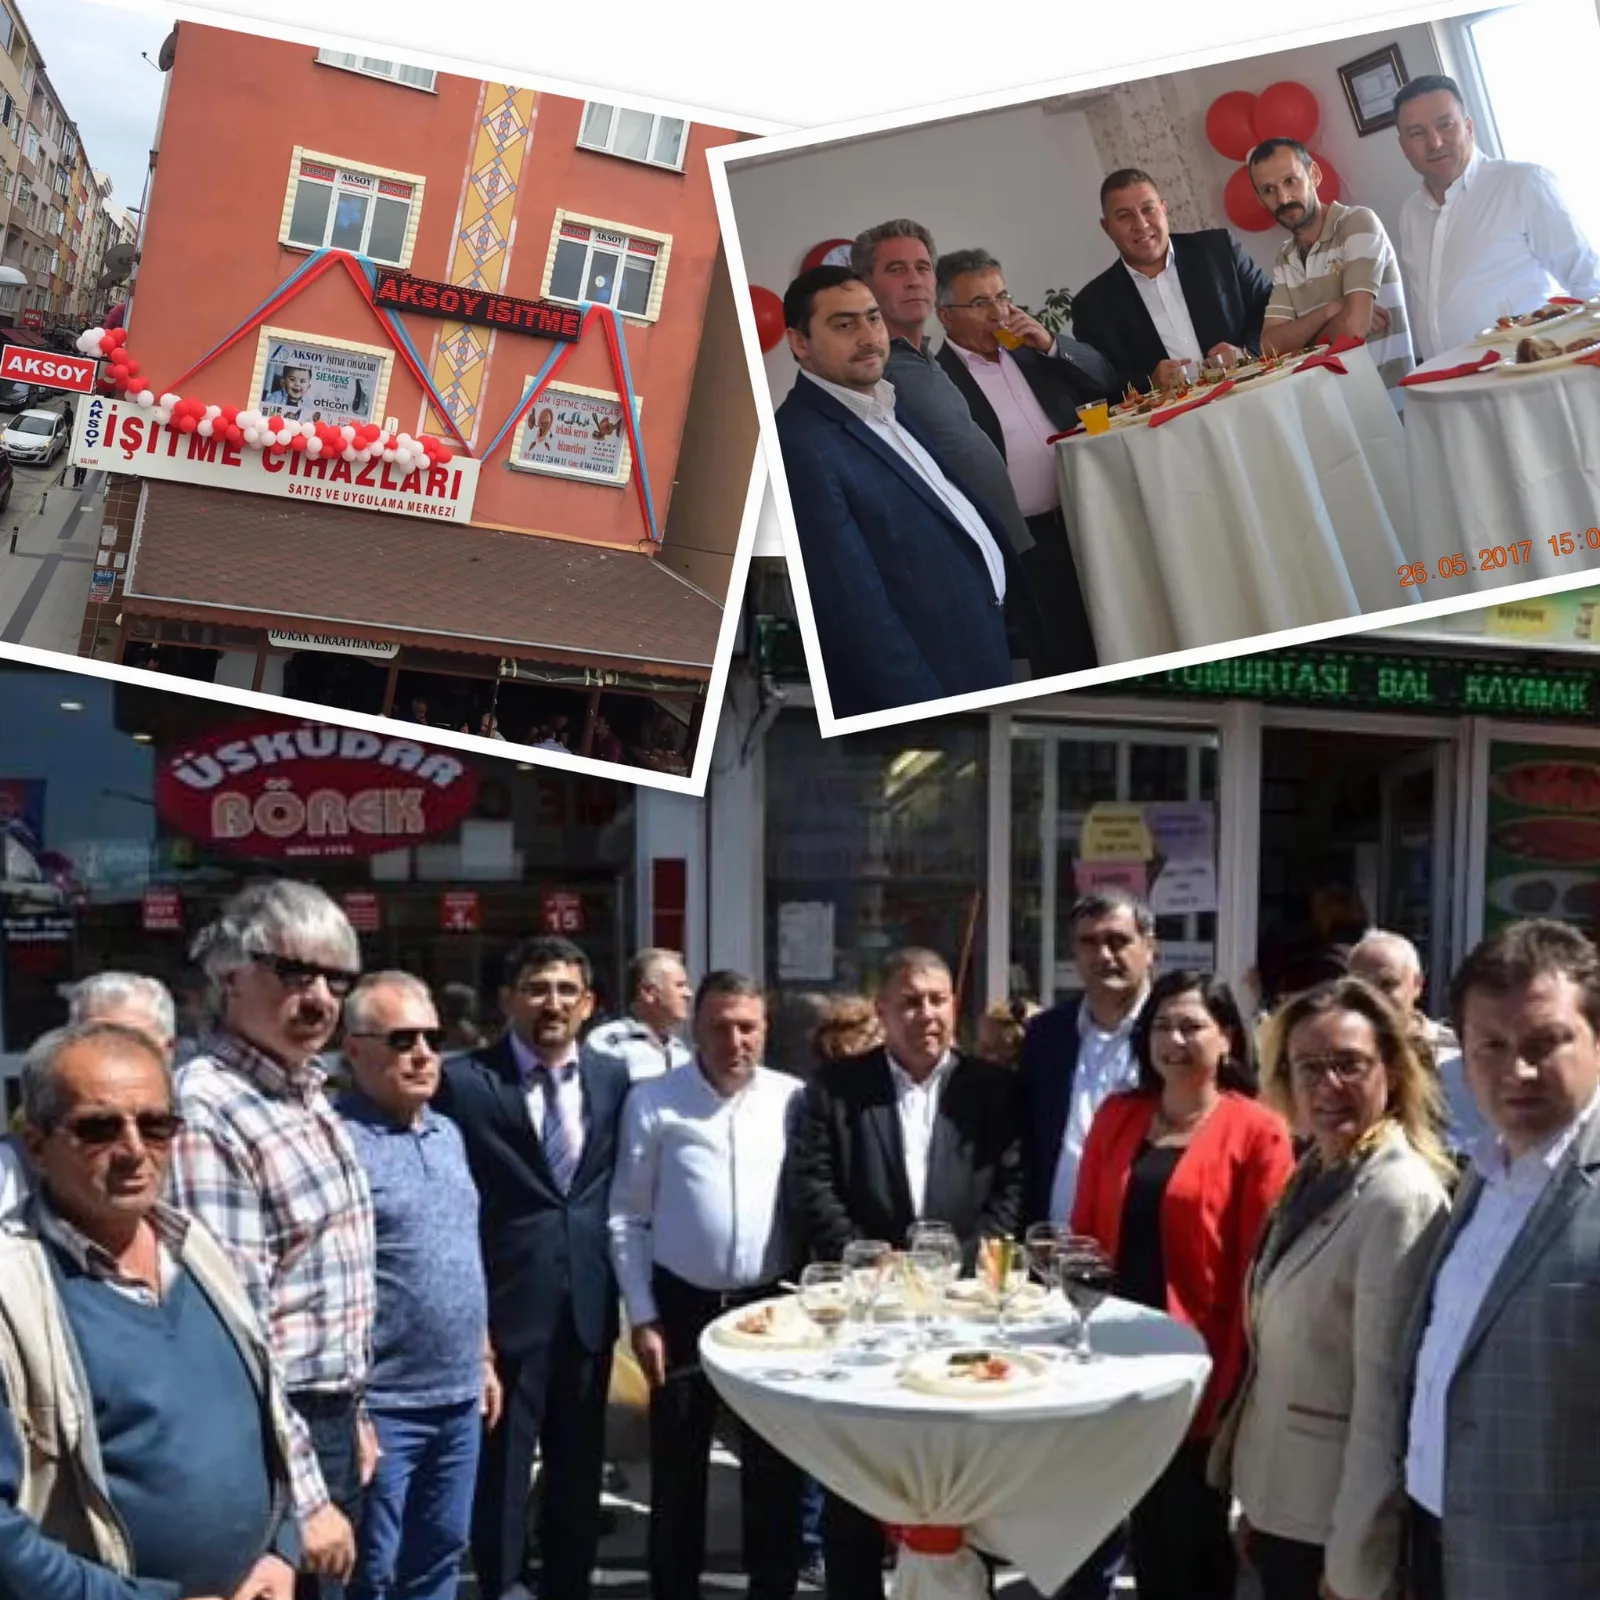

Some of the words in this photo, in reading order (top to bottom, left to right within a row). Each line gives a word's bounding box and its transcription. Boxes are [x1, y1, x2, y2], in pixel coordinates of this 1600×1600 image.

[341, 173, 373, 186] AKSOY
[595, 232, 622, 244] AKSOY
[378, 278, 482, 316] AKSOY
[486, 299, 579, 336] ISITME
[7, 355, 88, 383] AKSOY
[291, 350, 325, 363] AKSOY
[315, 371, 350, 385] SIEMENS
[313, 397, 349, 412] oticon
[85, 400, 104, 448] AKSOY
[288, 483, 322, 500] SATIŞ
[325, 488, 339, 500] VE
[343, 491, 404, 510] UYGULAMA
[407, 500, 456, 518] MERKEZİ
[171, 721, 464, 789] ÜSKÜDAR
[210, 778, 426, 839] BÖREK
